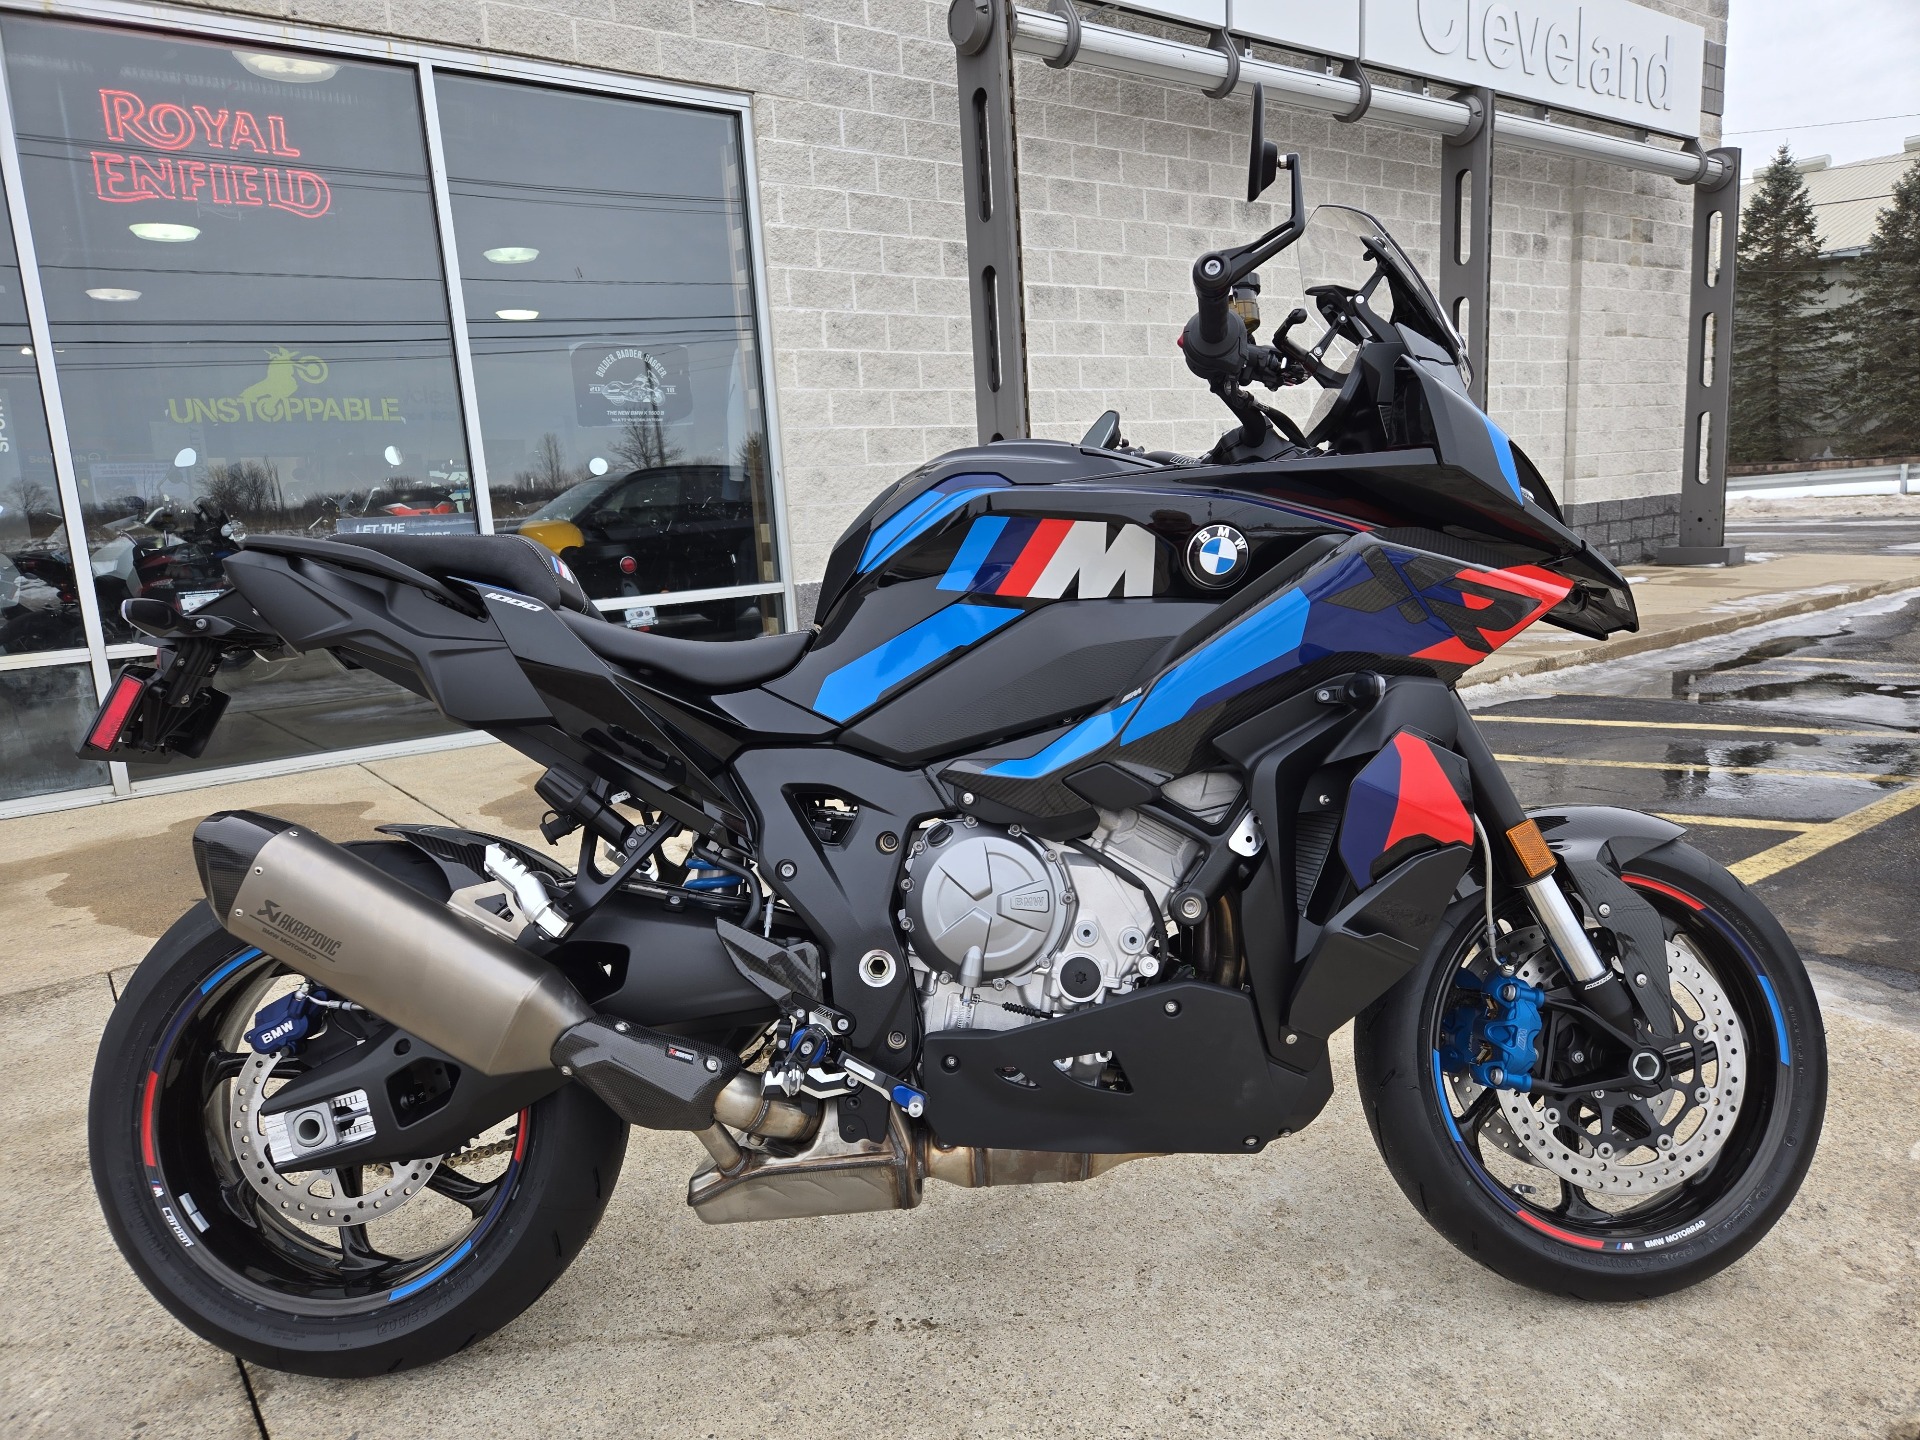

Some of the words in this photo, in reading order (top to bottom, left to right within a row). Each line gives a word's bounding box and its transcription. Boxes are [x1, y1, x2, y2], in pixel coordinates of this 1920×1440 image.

[1417, 0, 1674, 110] Cleveland
[90, 151, 331, 218] ENFIELD
[168, 397, 401, 424] UNSTOPPABLE
[356, 524, 379, 534] LET
[382, 523, 405, 533] THE
[1197, 525, 1247, 552] BMW
[1026, 520, 1155, 600] M
[484, 592, 545, 612] 1000
[261, 1020, 294, 1044] BMW
[1644, 1238, 1665, 1249] BMW
[1664, 1219, 1707, 1244] MOTORRAD
